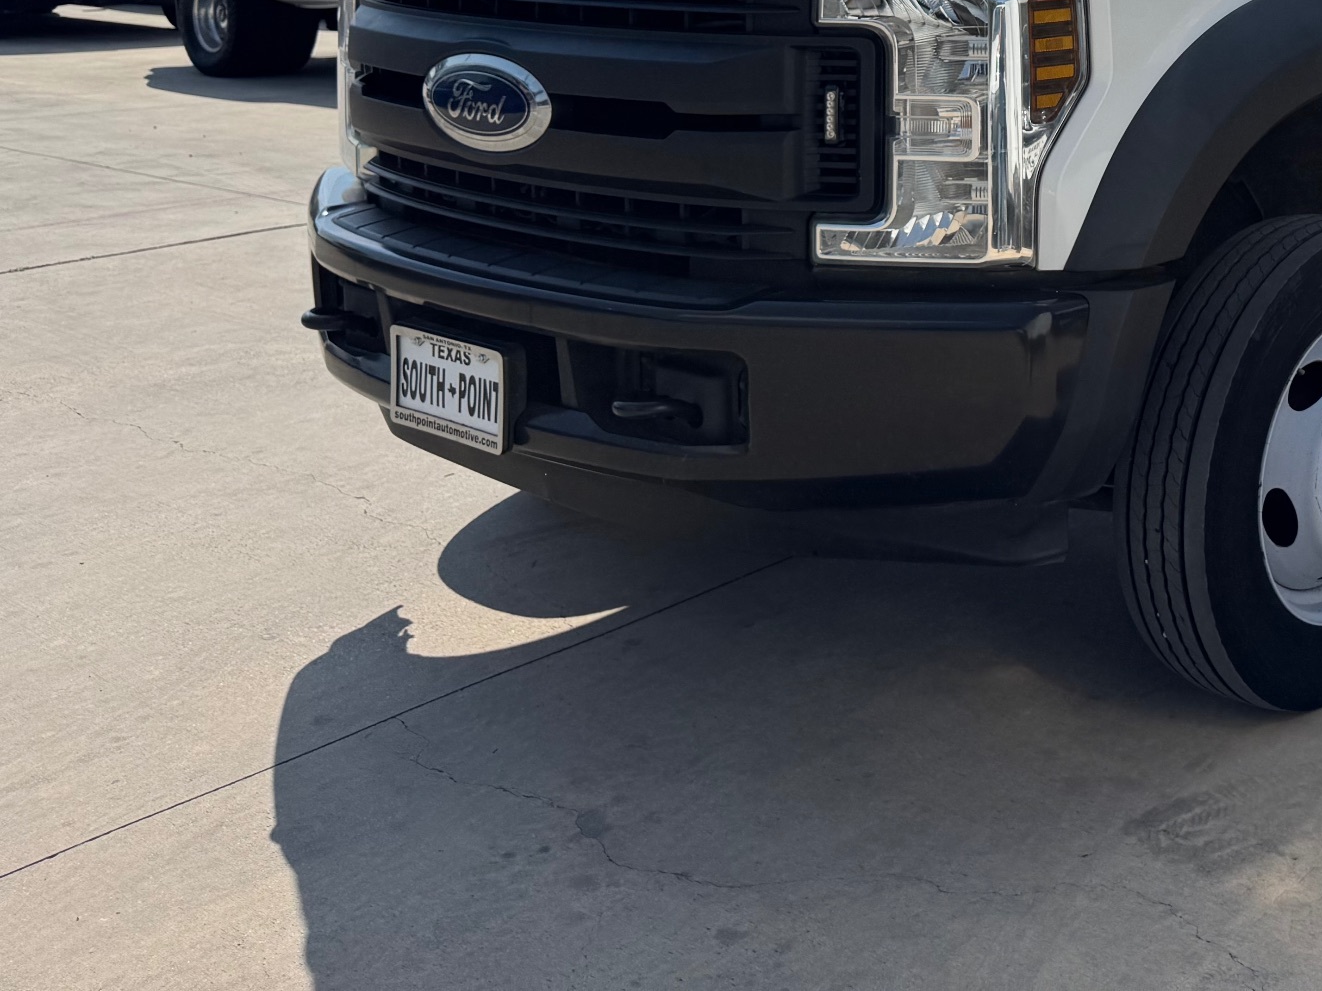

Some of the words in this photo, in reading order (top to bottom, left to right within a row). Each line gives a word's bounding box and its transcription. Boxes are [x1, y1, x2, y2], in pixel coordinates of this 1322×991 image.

[447, 78, 507, 125] Ford
[429, 342, 472, 366] TEXAS
[401, 356, 446, 409] SOUTH
[458, 372, 499, 424] POINT
[394, 410, 498, 450] southpointautomotive.com
